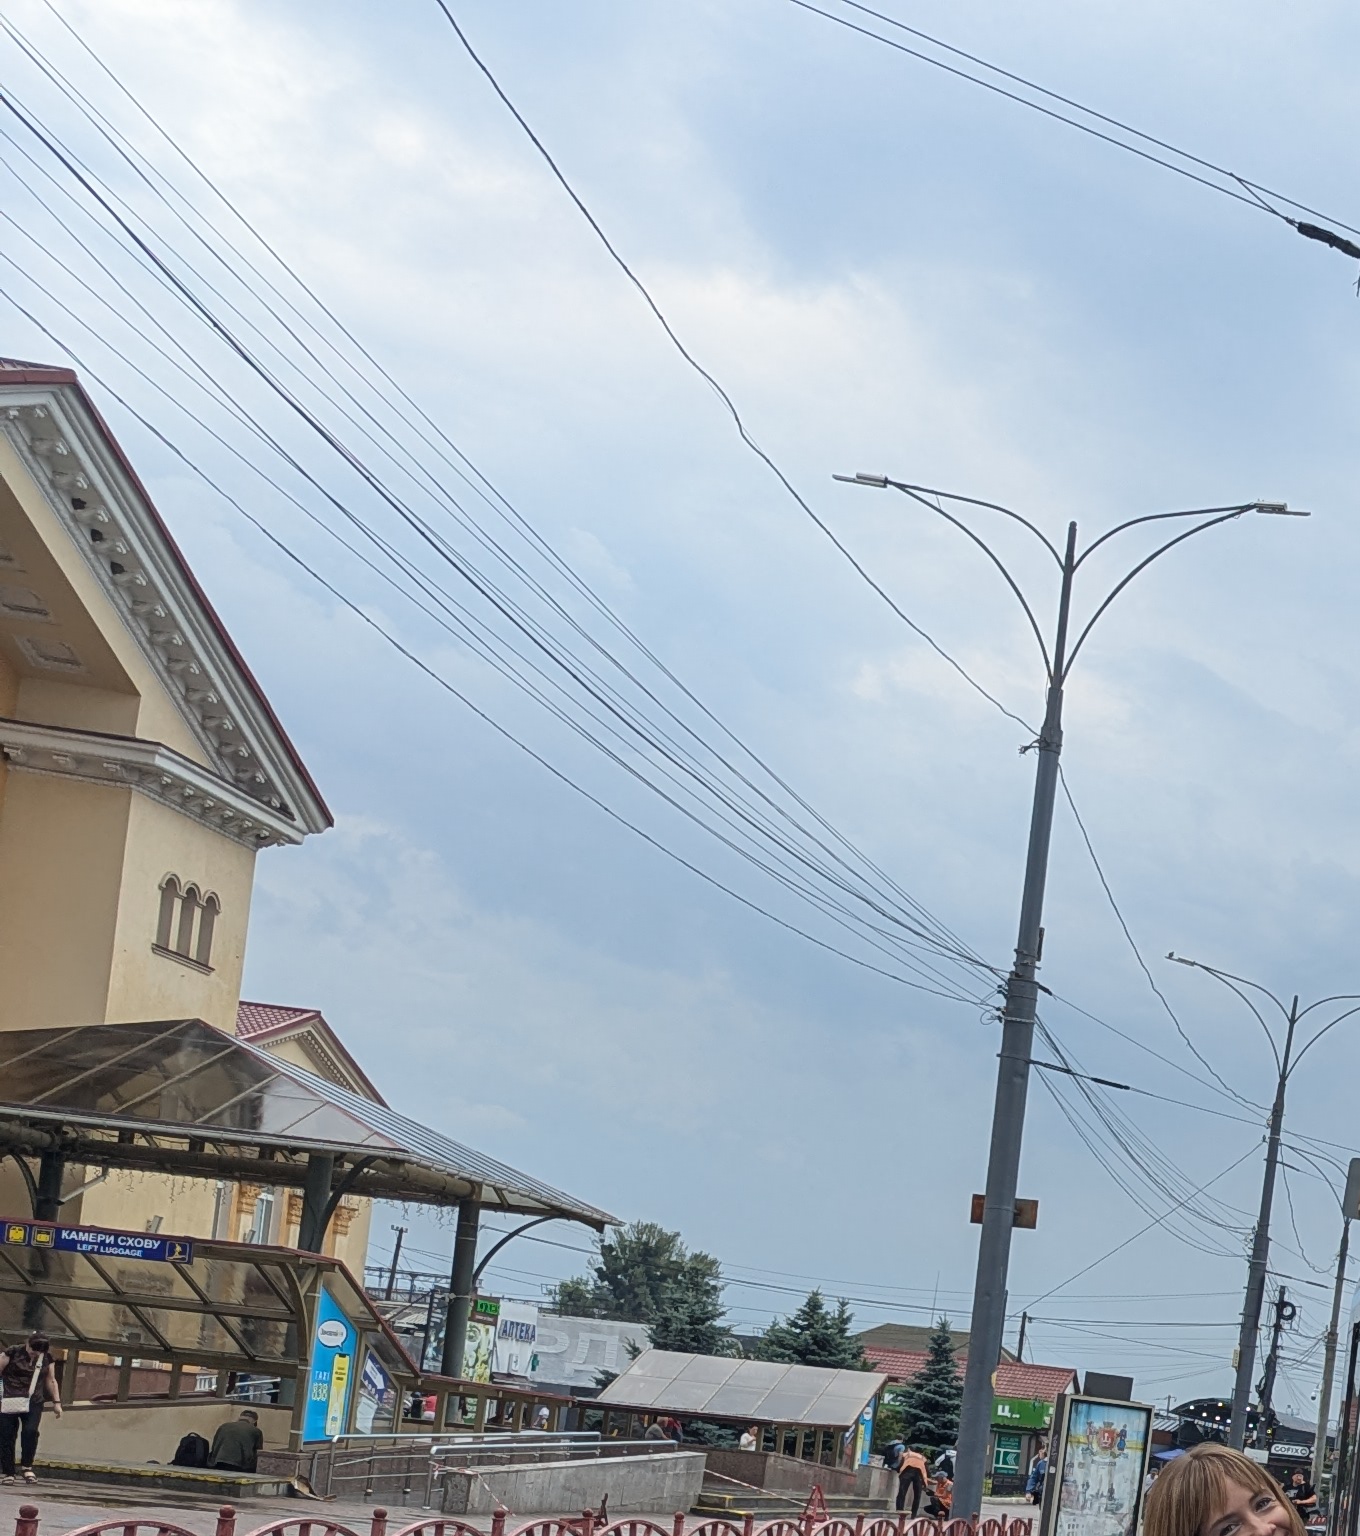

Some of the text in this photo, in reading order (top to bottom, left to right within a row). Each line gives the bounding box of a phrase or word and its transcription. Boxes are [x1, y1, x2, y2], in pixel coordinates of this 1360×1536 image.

[61, 1229, 161, 1250] КАМЕРИ СХОВУ
[77, 1243, 143, 1257] LEFT LUGGAGE
[501, 1318, 536, 1342] АПТЕКА
